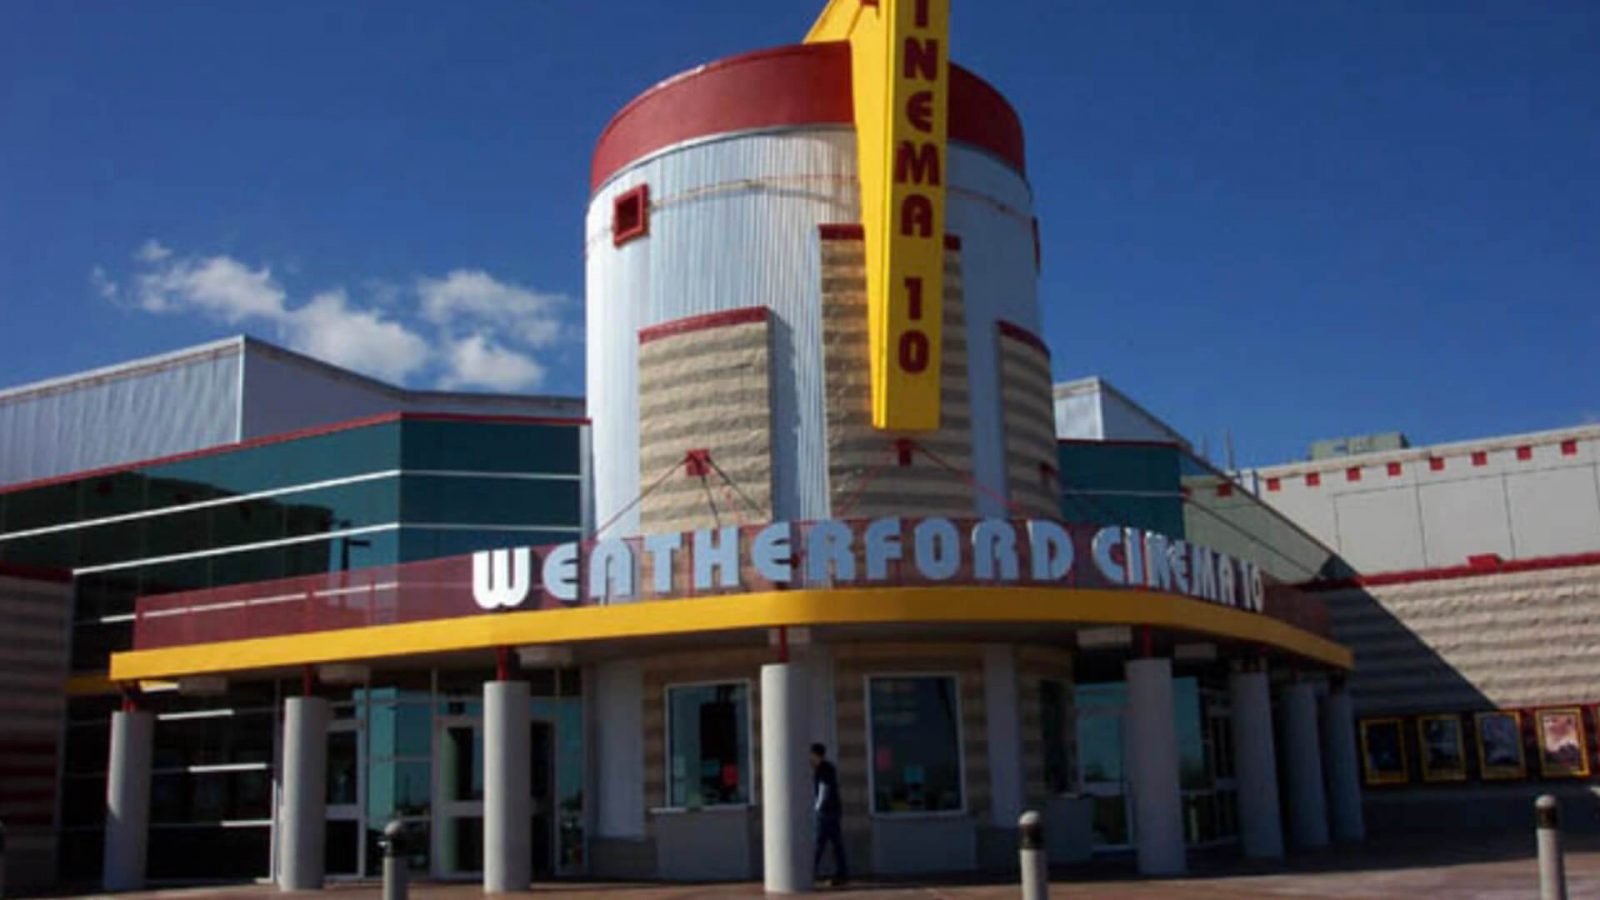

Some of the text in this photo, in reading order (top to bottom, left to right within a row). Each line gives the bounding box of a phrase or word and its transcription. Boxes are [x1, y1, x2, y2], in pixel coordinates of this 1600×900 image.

[898, 277, 930, 374] 10
[472, 518, 1264, 613] WEATHERFORD CINEMA 10
